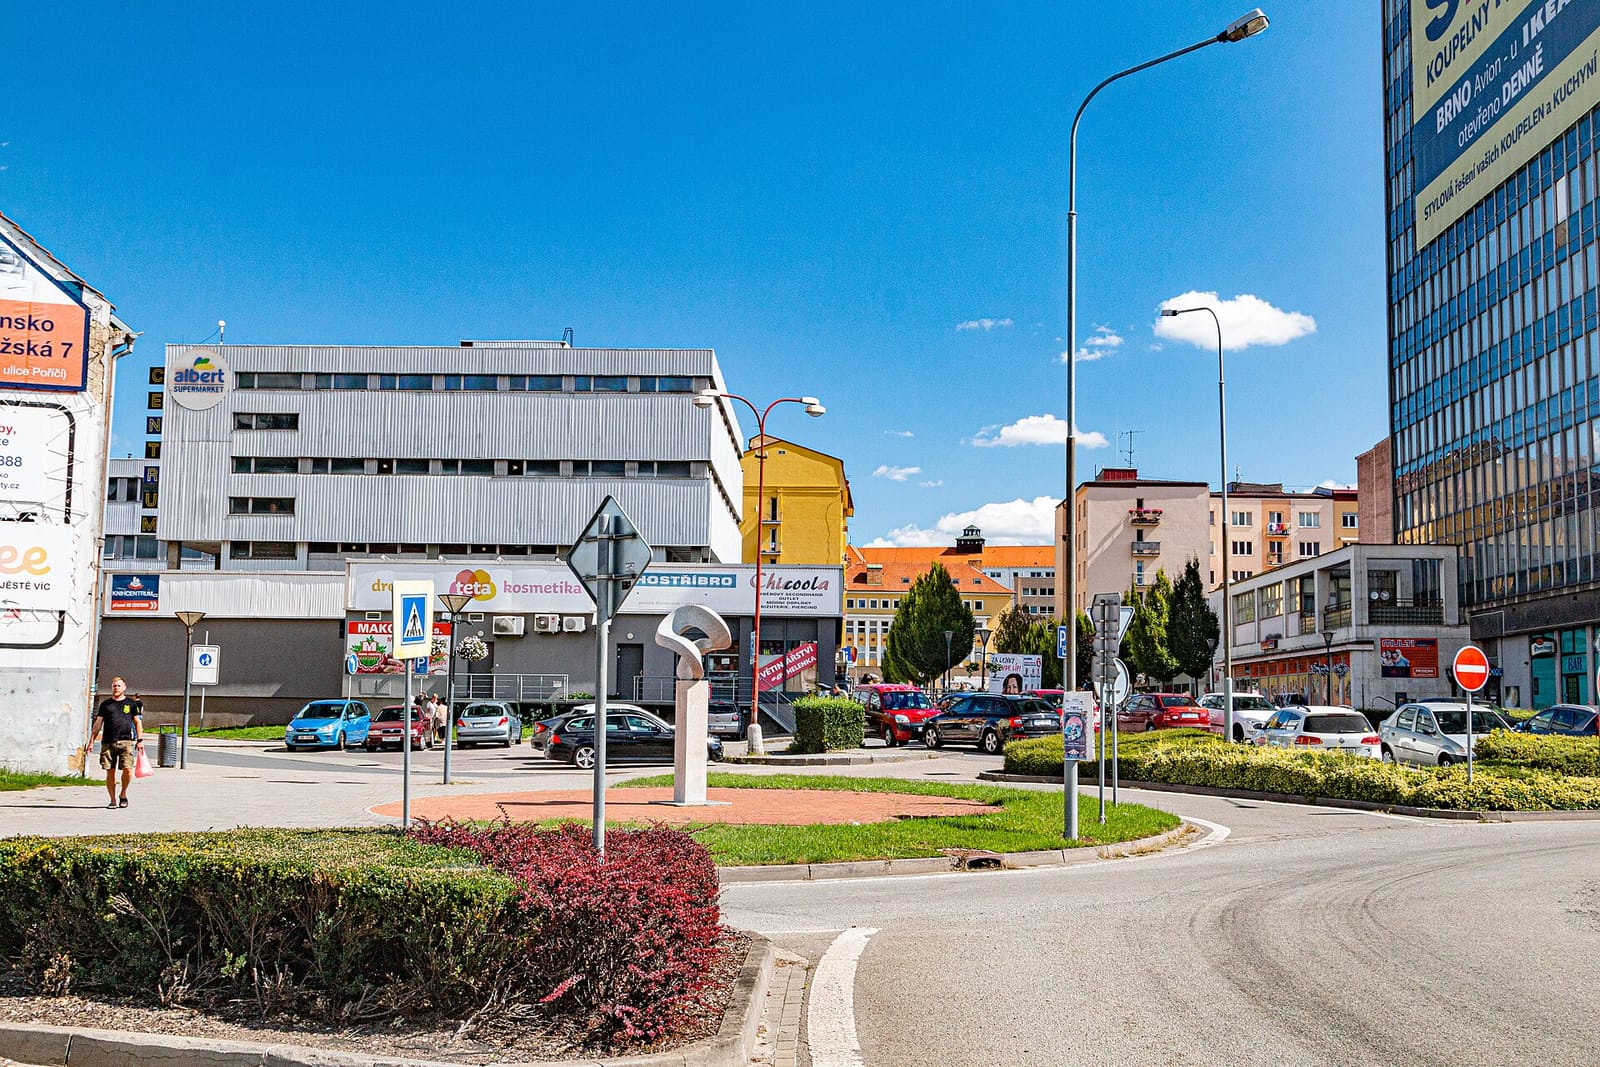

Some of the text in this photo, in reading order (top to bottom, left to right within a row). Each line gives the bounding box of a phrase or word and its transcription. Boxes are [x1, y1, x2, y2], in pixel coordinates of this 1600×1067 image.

[1426, 3, 1490, 88] KOUPELNY
[1437, 80, 1471, 134] BRNO
[1474, 59, 1501, 98] Avion
[1511, 40, 1518, 58] u
[1522, 0, 1571, 48] IKEA
[1458, 97, 1501, 147] otevřeno
[1502, 42, 1544, 107] DENNĚ
[1424, 49, 1598, 221] STYLOVÁ řešení vašich KOUPELEN a KUCHYNÍ
[0, 314, 54, 332] nsko
[0, 336, 73, 358] žská 7
[3, 365, 67, 380] ulice Poříčí)
[174, 368, 225, 383] albert
[173, 385, 224, 393] SUPERMARKET
[142, 368, 164, 532] CENTRUM
[455, 580, 492, 595] teta
[503, 580, 582, 595] kosmetika
[749, 572, 829, 591] Chicoola
[1381, 639, 1415, 648] MULTI
[759, 645, 814, 681] VĚTINÁŘSTVÍ
[786, 656, 816, 676] HELENKA
[1568, 657, 1583, 671] BAR
